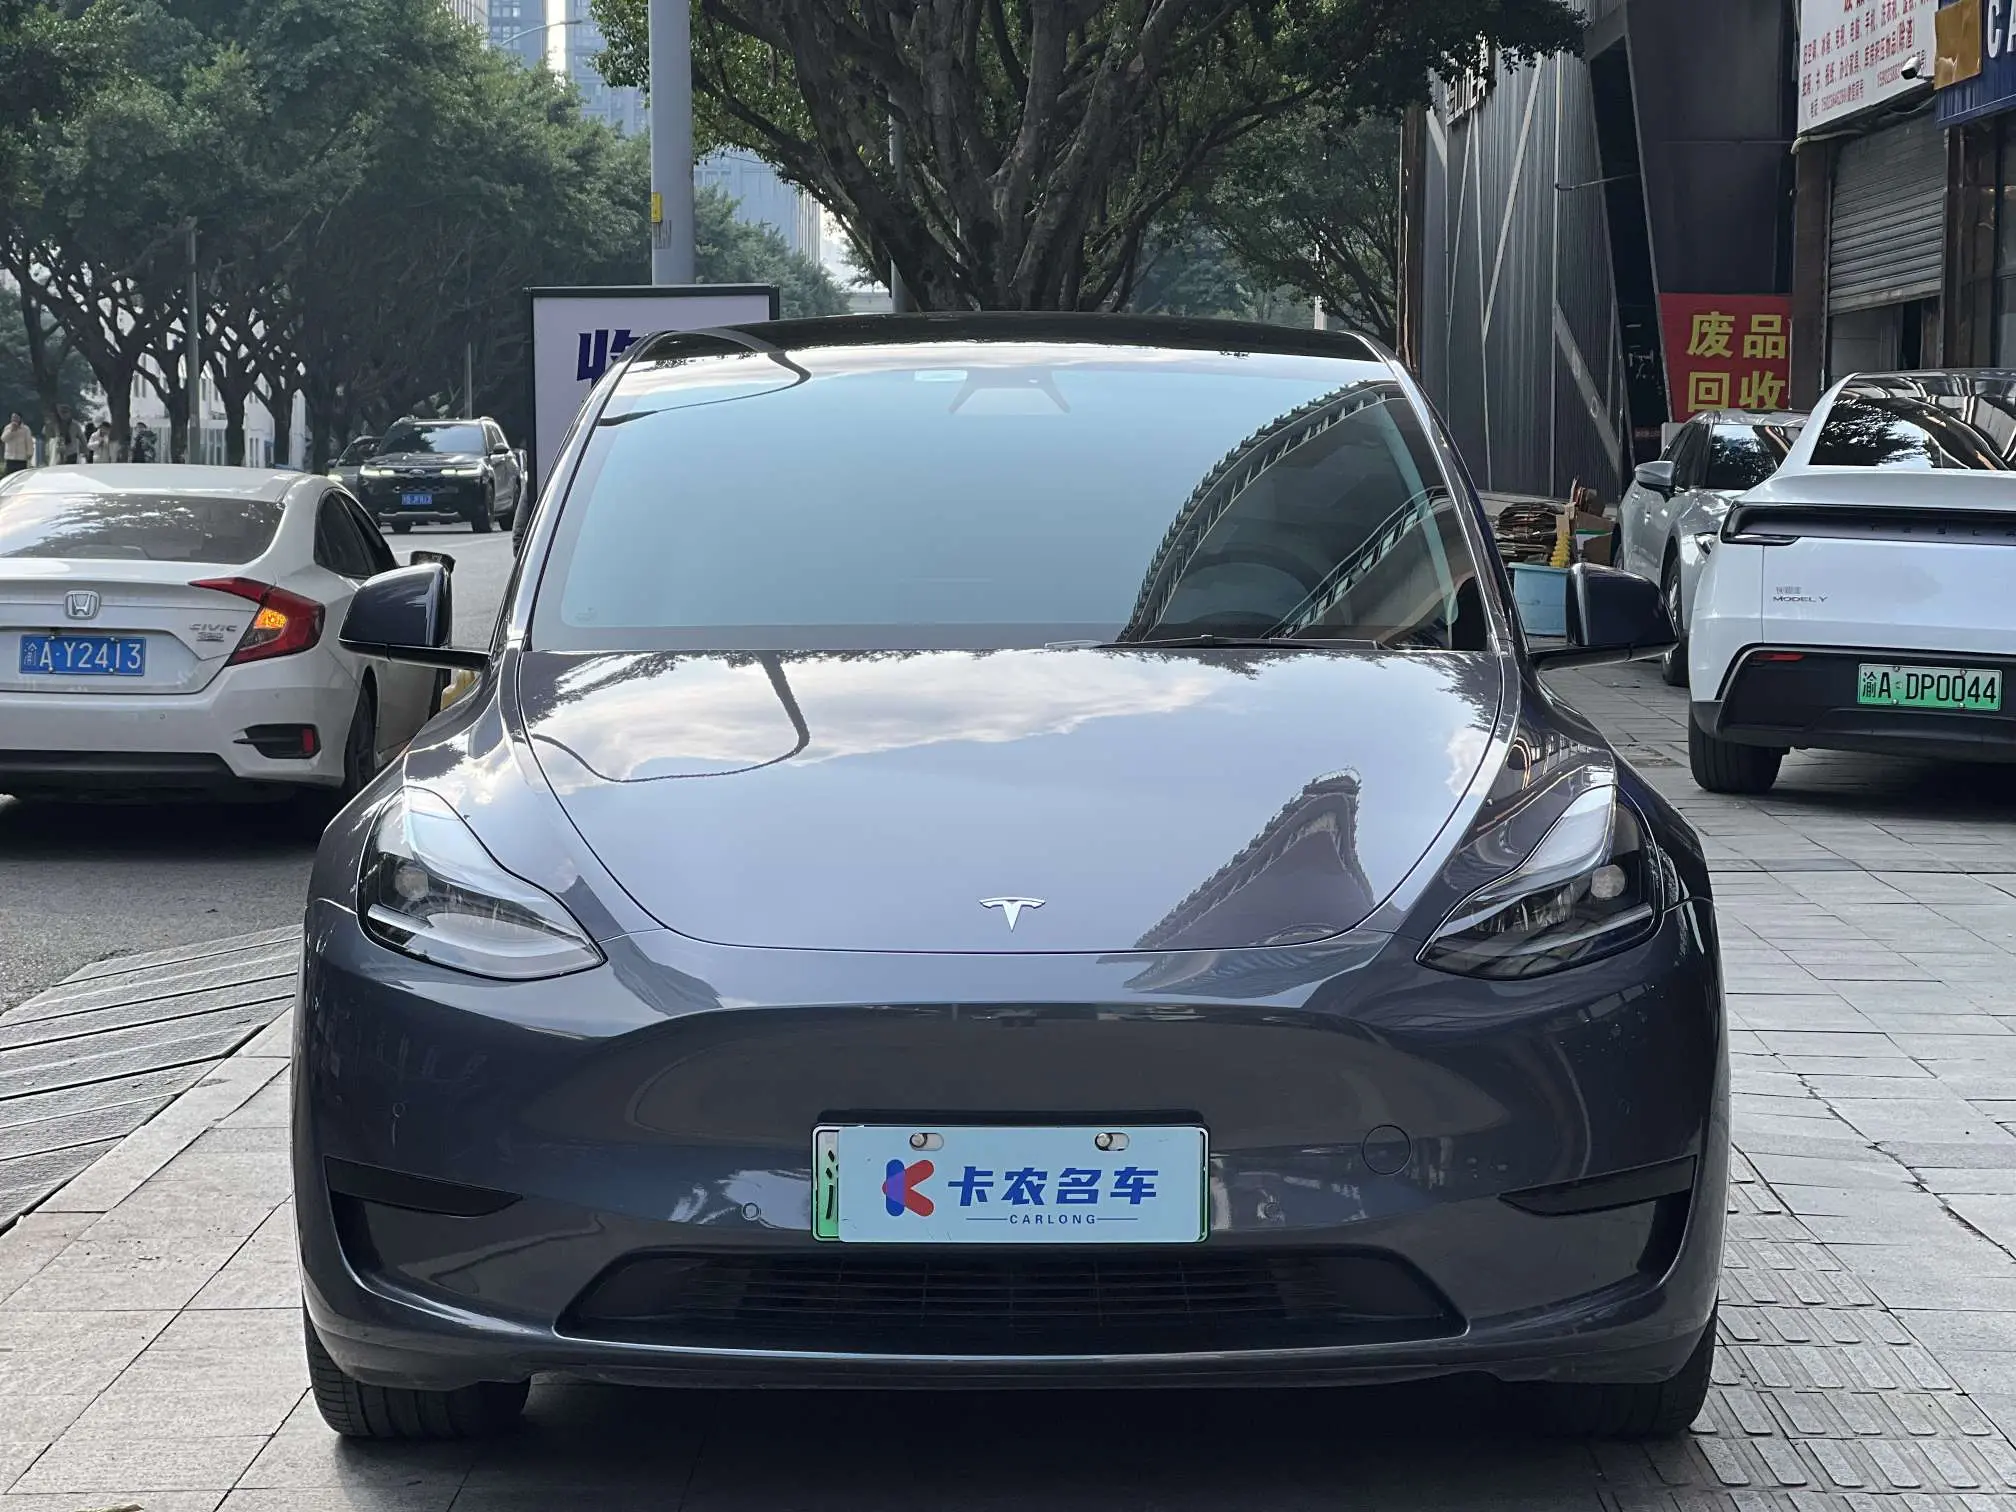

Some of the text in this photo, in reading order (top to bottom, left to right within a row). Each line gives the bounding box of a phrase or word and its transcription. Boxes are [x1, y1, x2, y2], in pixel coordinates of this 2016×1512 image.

[1686, 311, 1786, 359] 废品
[1687, 371, 1786, 412] 回收
[189, 623, 237, 632] CIVIC
[948, 1165, 1159, 1206] 卡农名车
[1009, 1214, 1096, 1225] CARLONG
